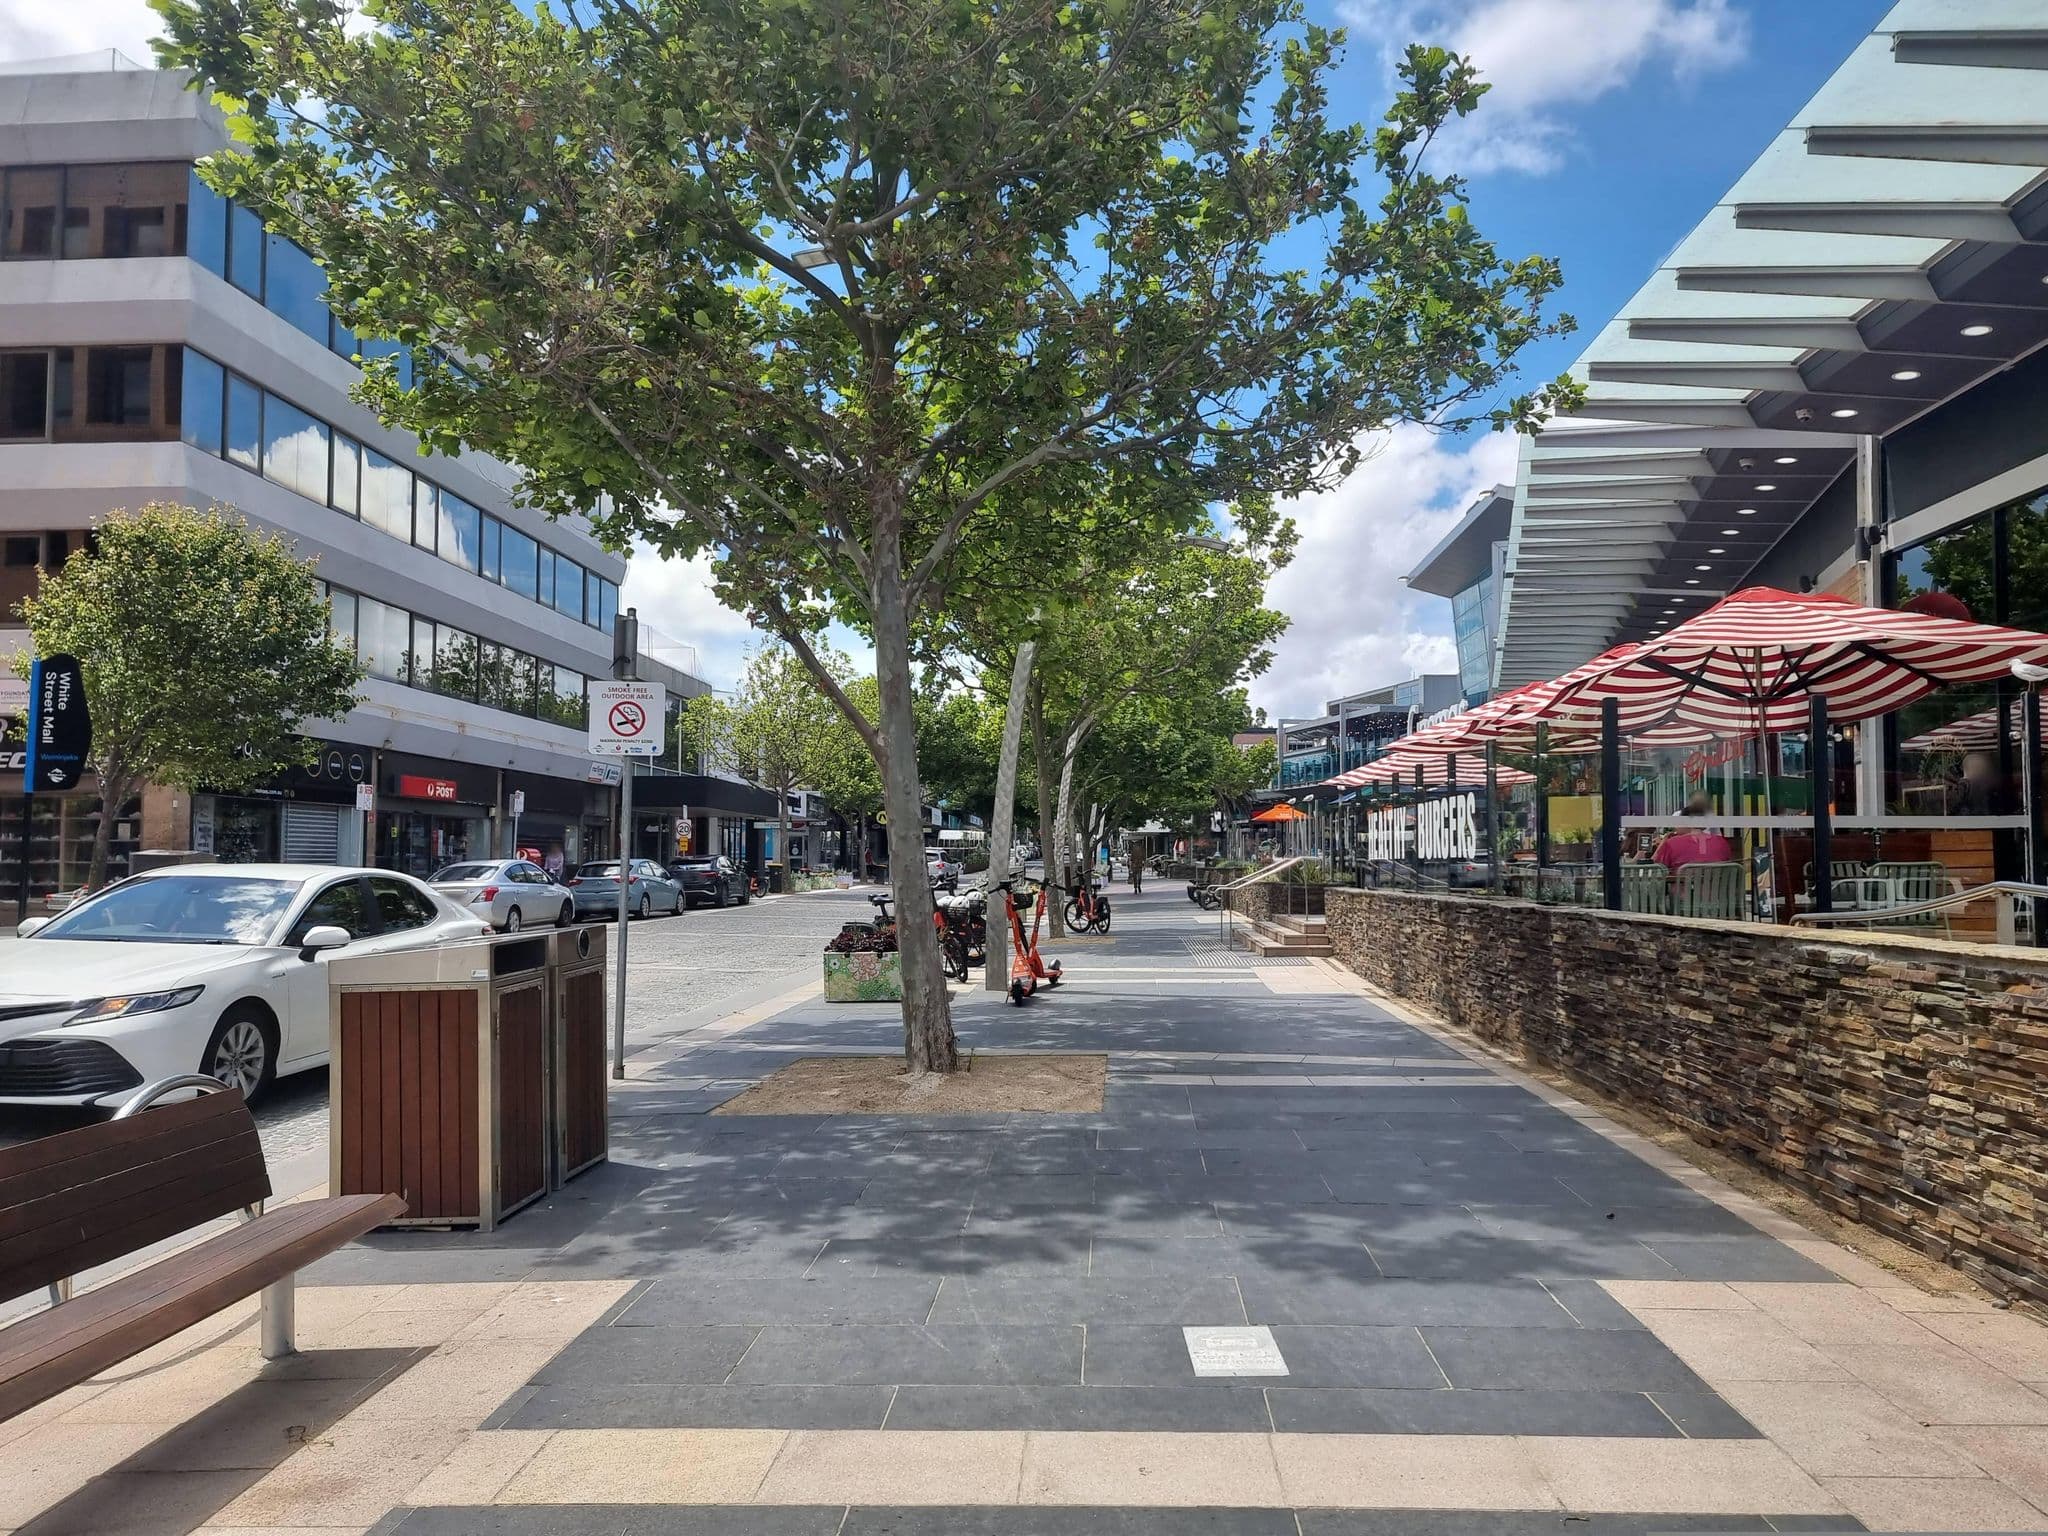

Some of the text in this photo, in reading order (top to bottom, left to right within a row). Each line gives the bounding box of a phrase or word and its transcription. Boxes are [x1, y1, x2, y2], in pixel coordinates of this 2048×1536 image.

[42, 671, 57, 744] Street Mall
[58, 672, 71, 711] White
[436, 786, 454, 798] POST
[1368, 791, 1476, 860] HEALTHY BURGERS
